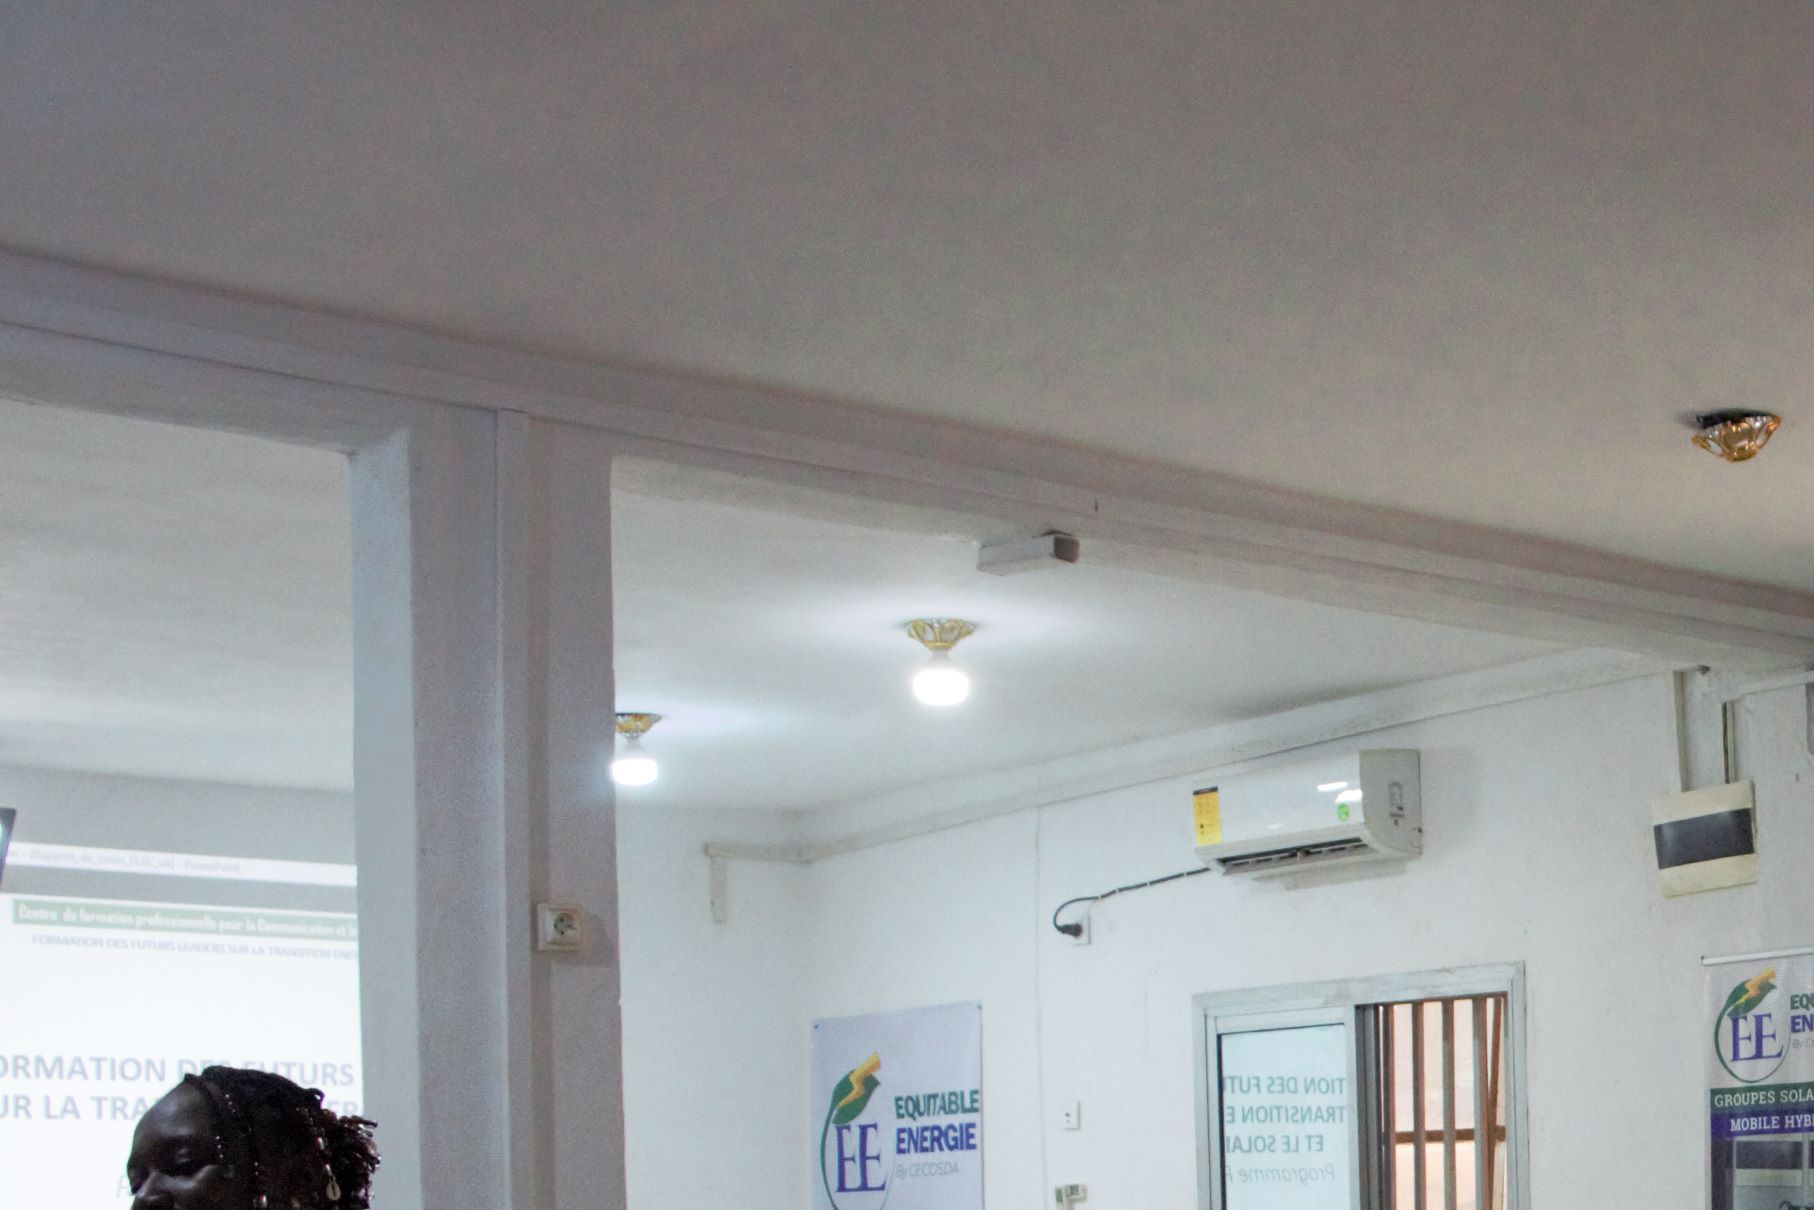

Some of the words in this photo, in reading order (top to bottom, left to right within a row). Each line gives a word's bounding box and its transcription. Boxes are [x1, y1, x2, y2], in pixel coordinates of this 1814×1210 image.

[18, 903, 57, 921] Centre
[32, 934, 104, 948] FORMATION
[106, 937, 129, 949] DES
[44, 1095, 81, 1120] LA
[894, 1088, 980, 1121] EQUITABLE
[1714, 1090, 1775, 1108] GROUPES
[1730, 1116, 1780, 1132] MOBILE
[896, 1122, 977, 1154] ENERGIE
[908, 1161, 959, 1177] CECOSDA
